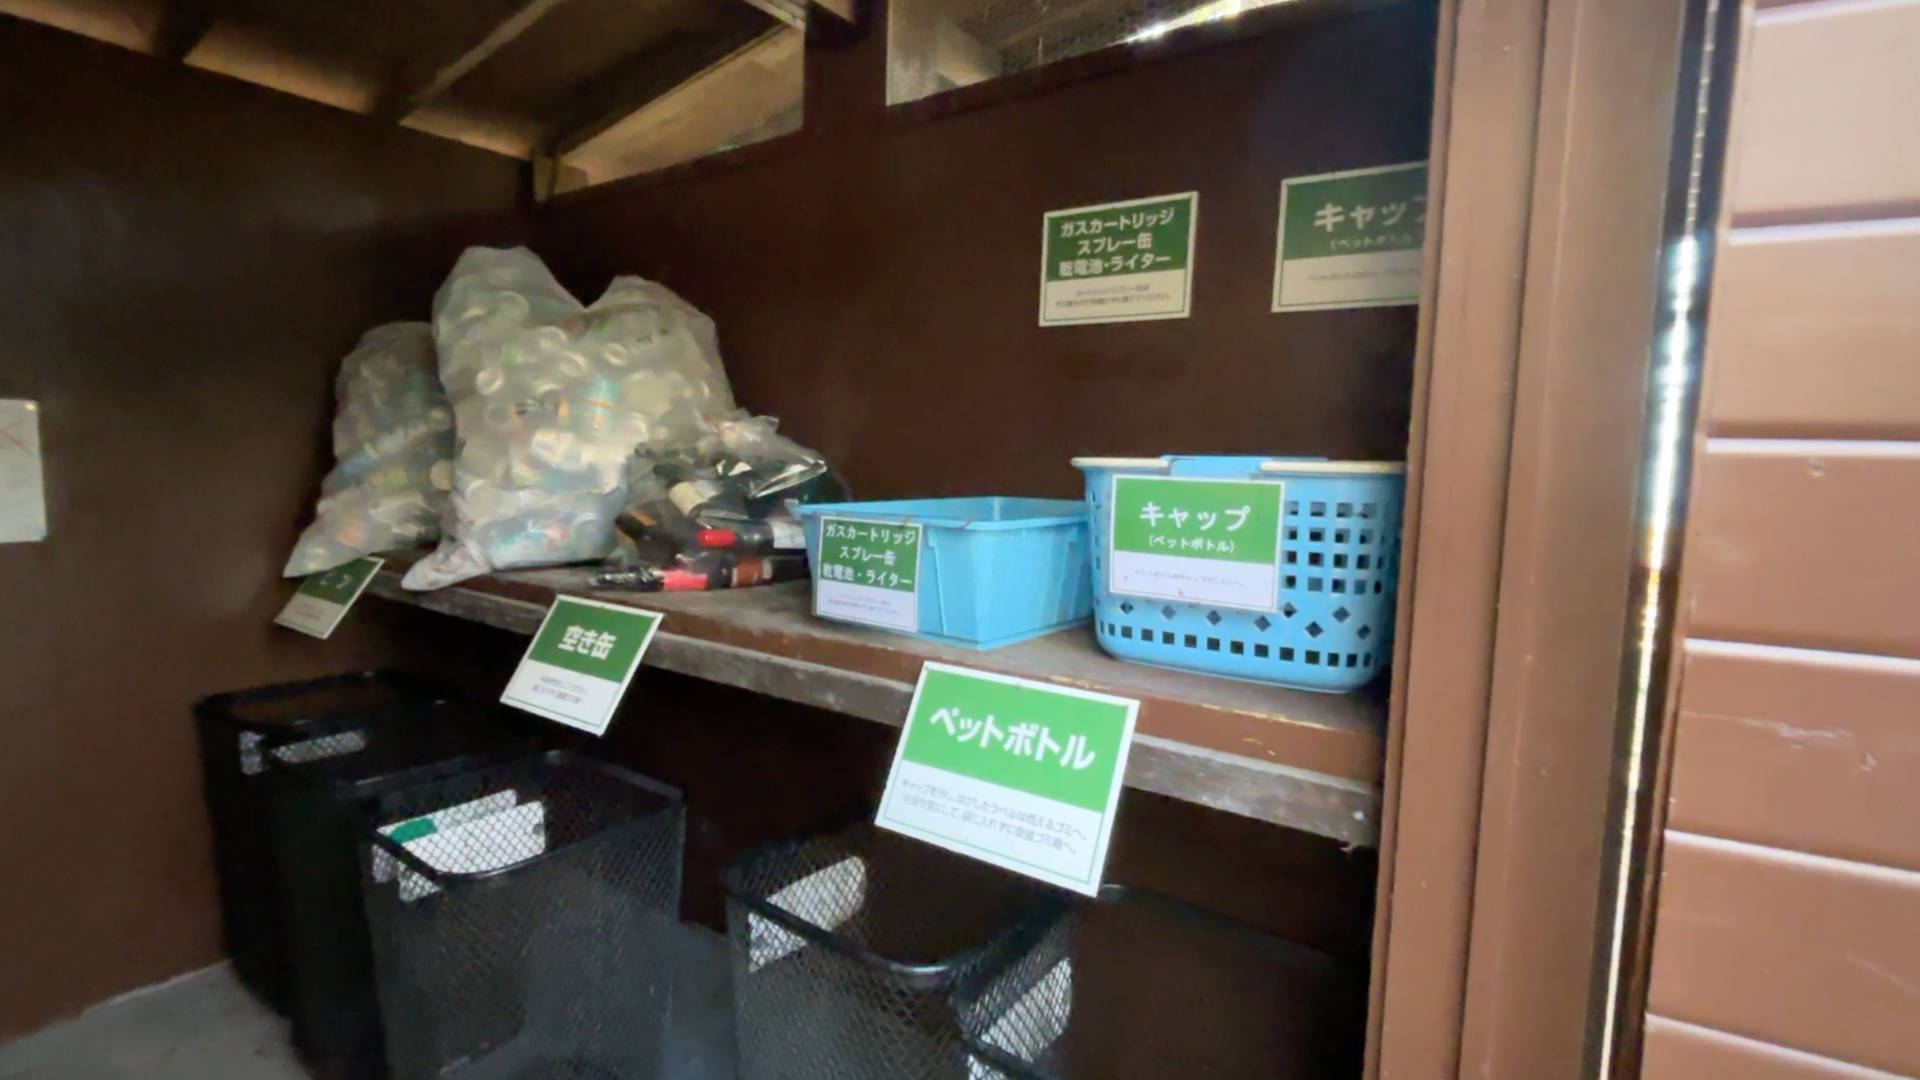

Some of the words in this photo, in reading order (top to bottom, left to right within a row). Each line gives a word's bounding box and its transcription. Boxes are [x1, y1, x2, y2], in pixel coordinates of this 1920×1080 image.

[1060, 207, 1175, 238] ガスカートリッジ
[1077, 232, 1153, 256] スプレー缶
[1139, 501, 1252, 532] キャップ
[826, 523, 917, 545] ガスカートリッジ
[1148, 534, 1236, 553] (ペットボトル)
[839, 545, 897, 566] スプレー缶
[557, 624, 617, 660] 空き缶
[930, 707, 1096, 770] ペットボトル
